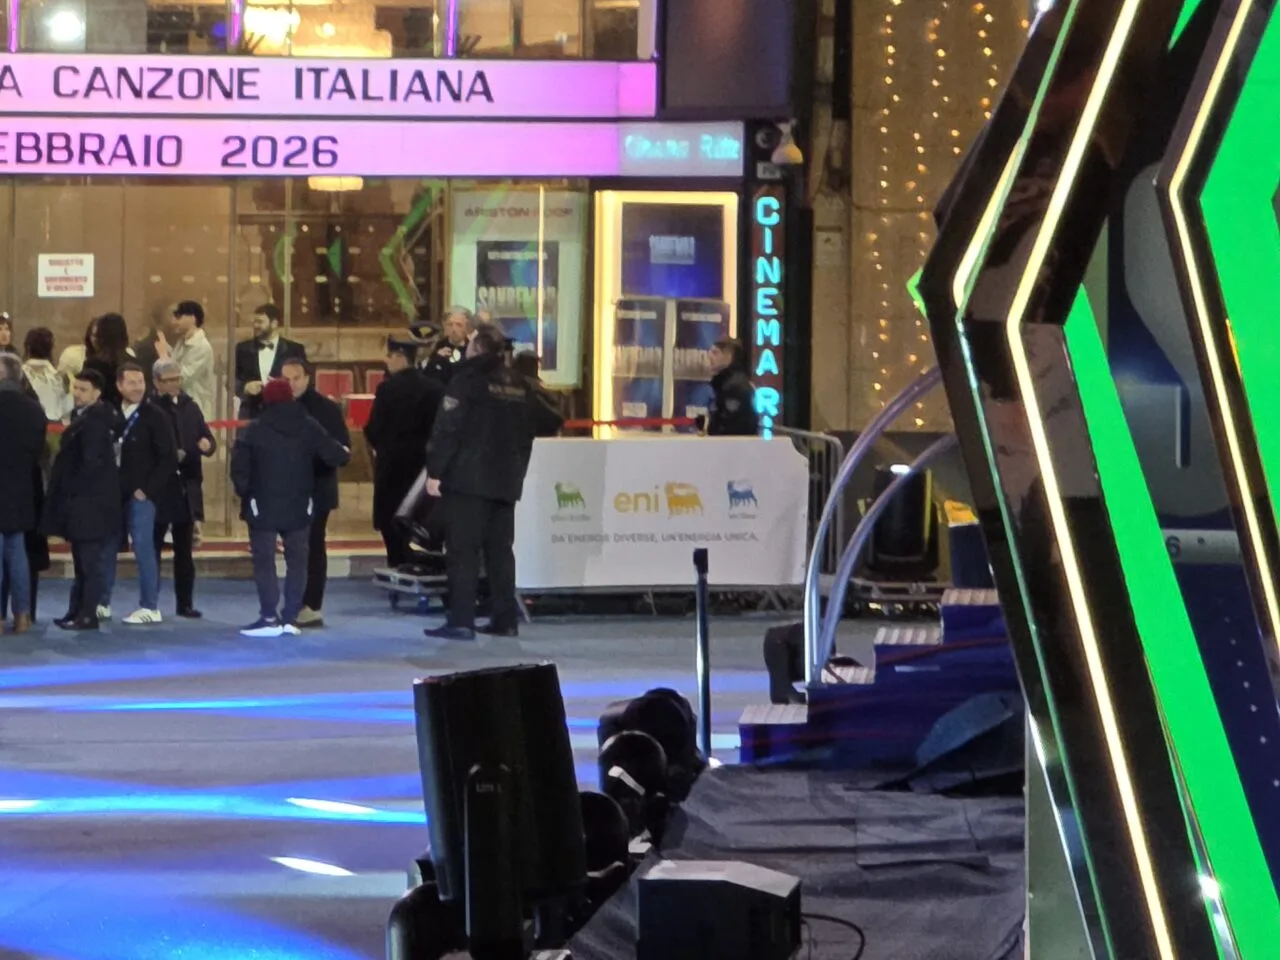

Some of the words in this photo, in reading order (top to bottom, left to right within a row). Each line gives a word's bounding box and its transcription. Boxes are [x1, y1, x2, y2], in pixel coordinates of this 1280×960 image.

[52, 65, 260, 100] CANZONE
[294, 67, 495, 104] ITALIANA
[221, 136, 338, 168] 2026
[756, 197, 780, 376] CINEMA
[614, 485, 659, 512] eni
